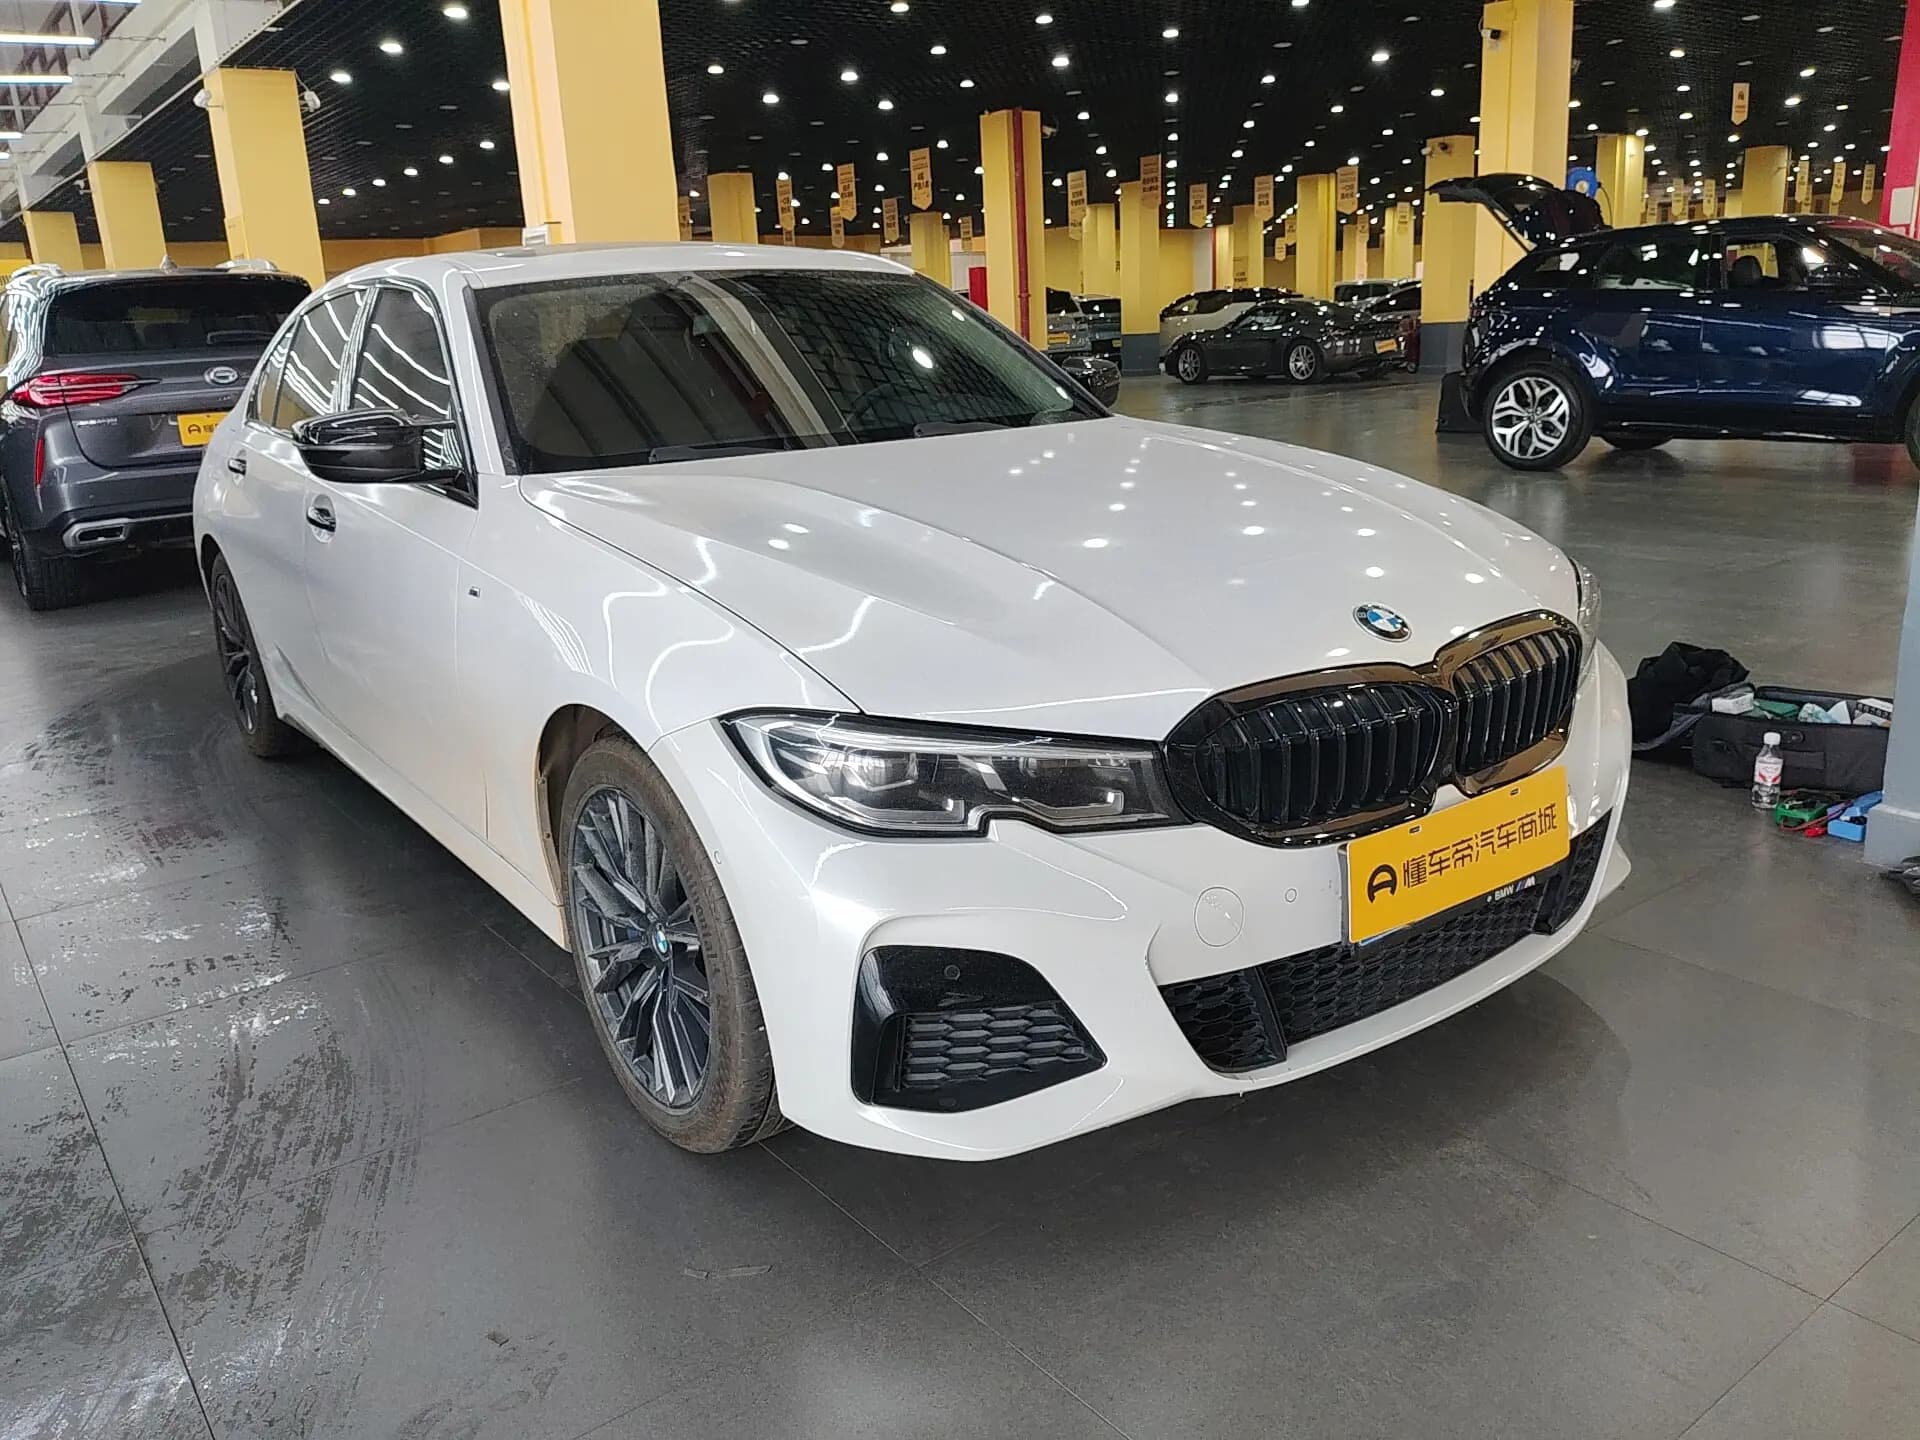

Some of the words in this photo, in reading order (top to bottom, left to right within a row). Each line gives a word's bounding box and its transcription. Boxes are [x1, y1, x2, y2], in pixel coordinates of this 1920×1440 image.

[1403, 803, 1557, 888] 懂车帝汽车商城
